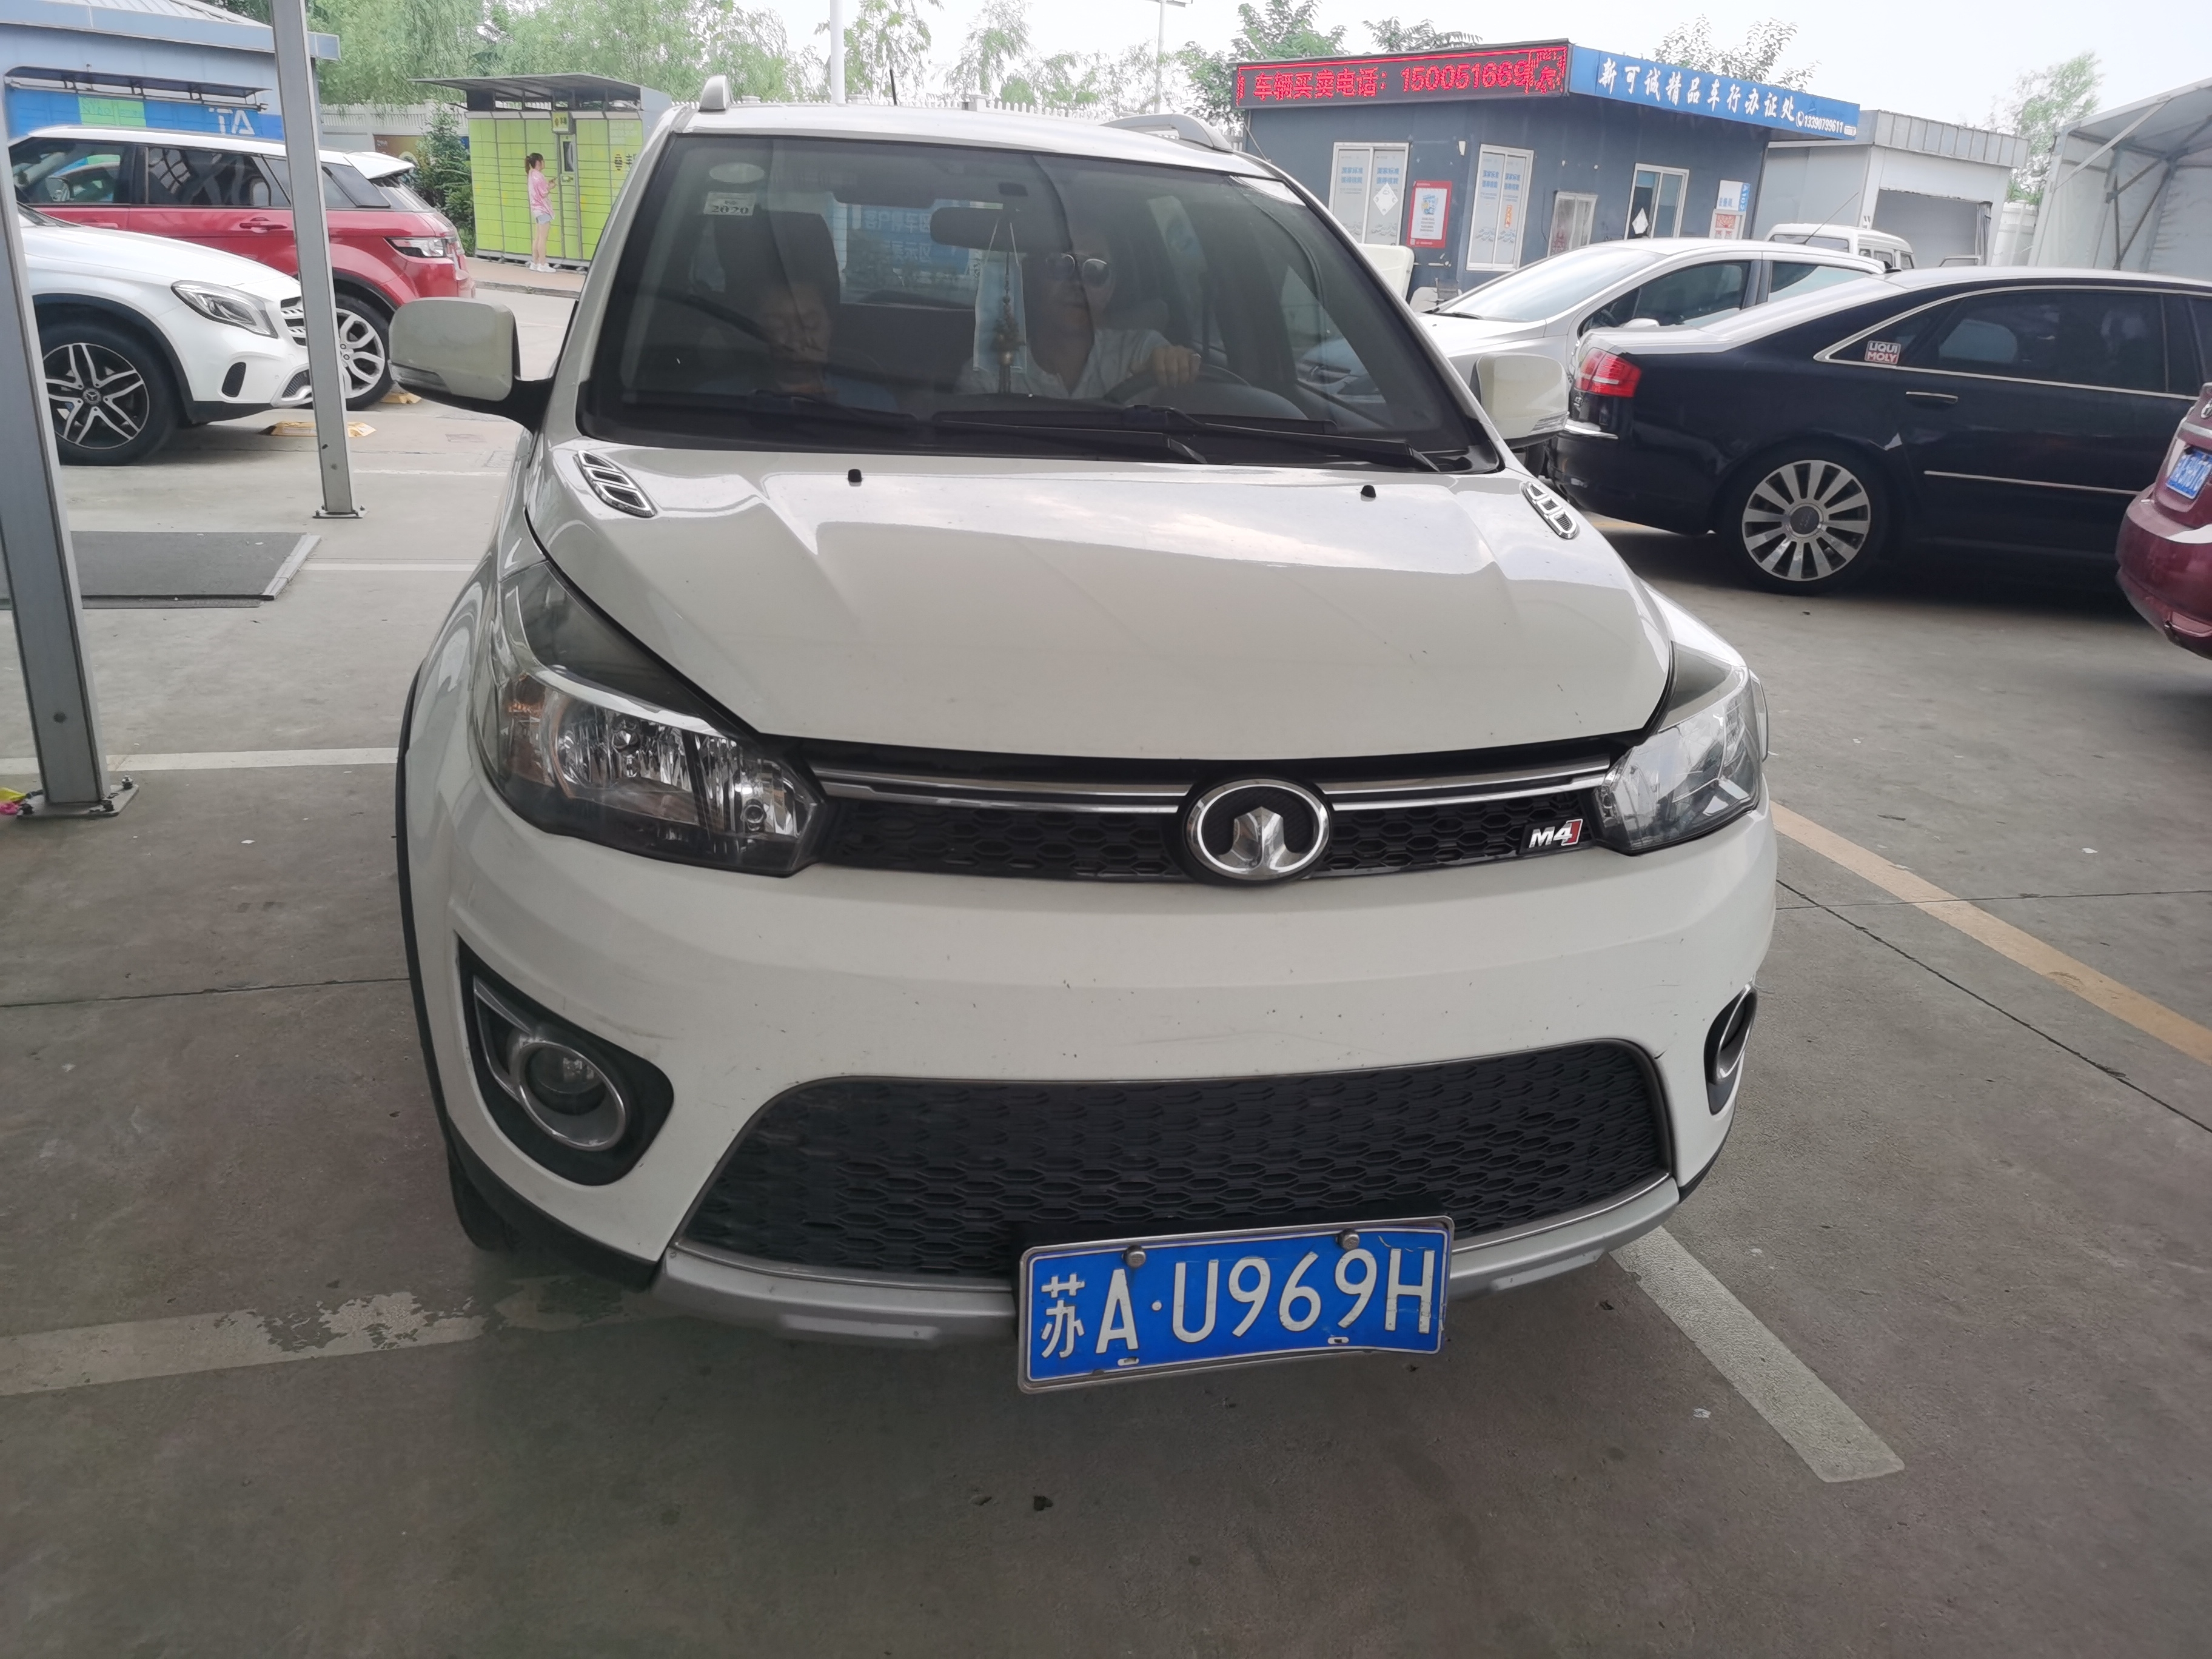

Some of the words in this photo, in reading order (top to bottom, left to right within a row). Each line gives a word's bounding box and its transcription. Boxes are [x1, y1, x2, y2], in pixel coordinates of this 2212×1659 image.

[1598, 58, 1795, 121] 新可诚精品车行办证处
[1868, 351, 1897, 363] MOLY
[1869, 342, 1899, 354] LIQUI
[1529, 820, 1579, 848] M4
